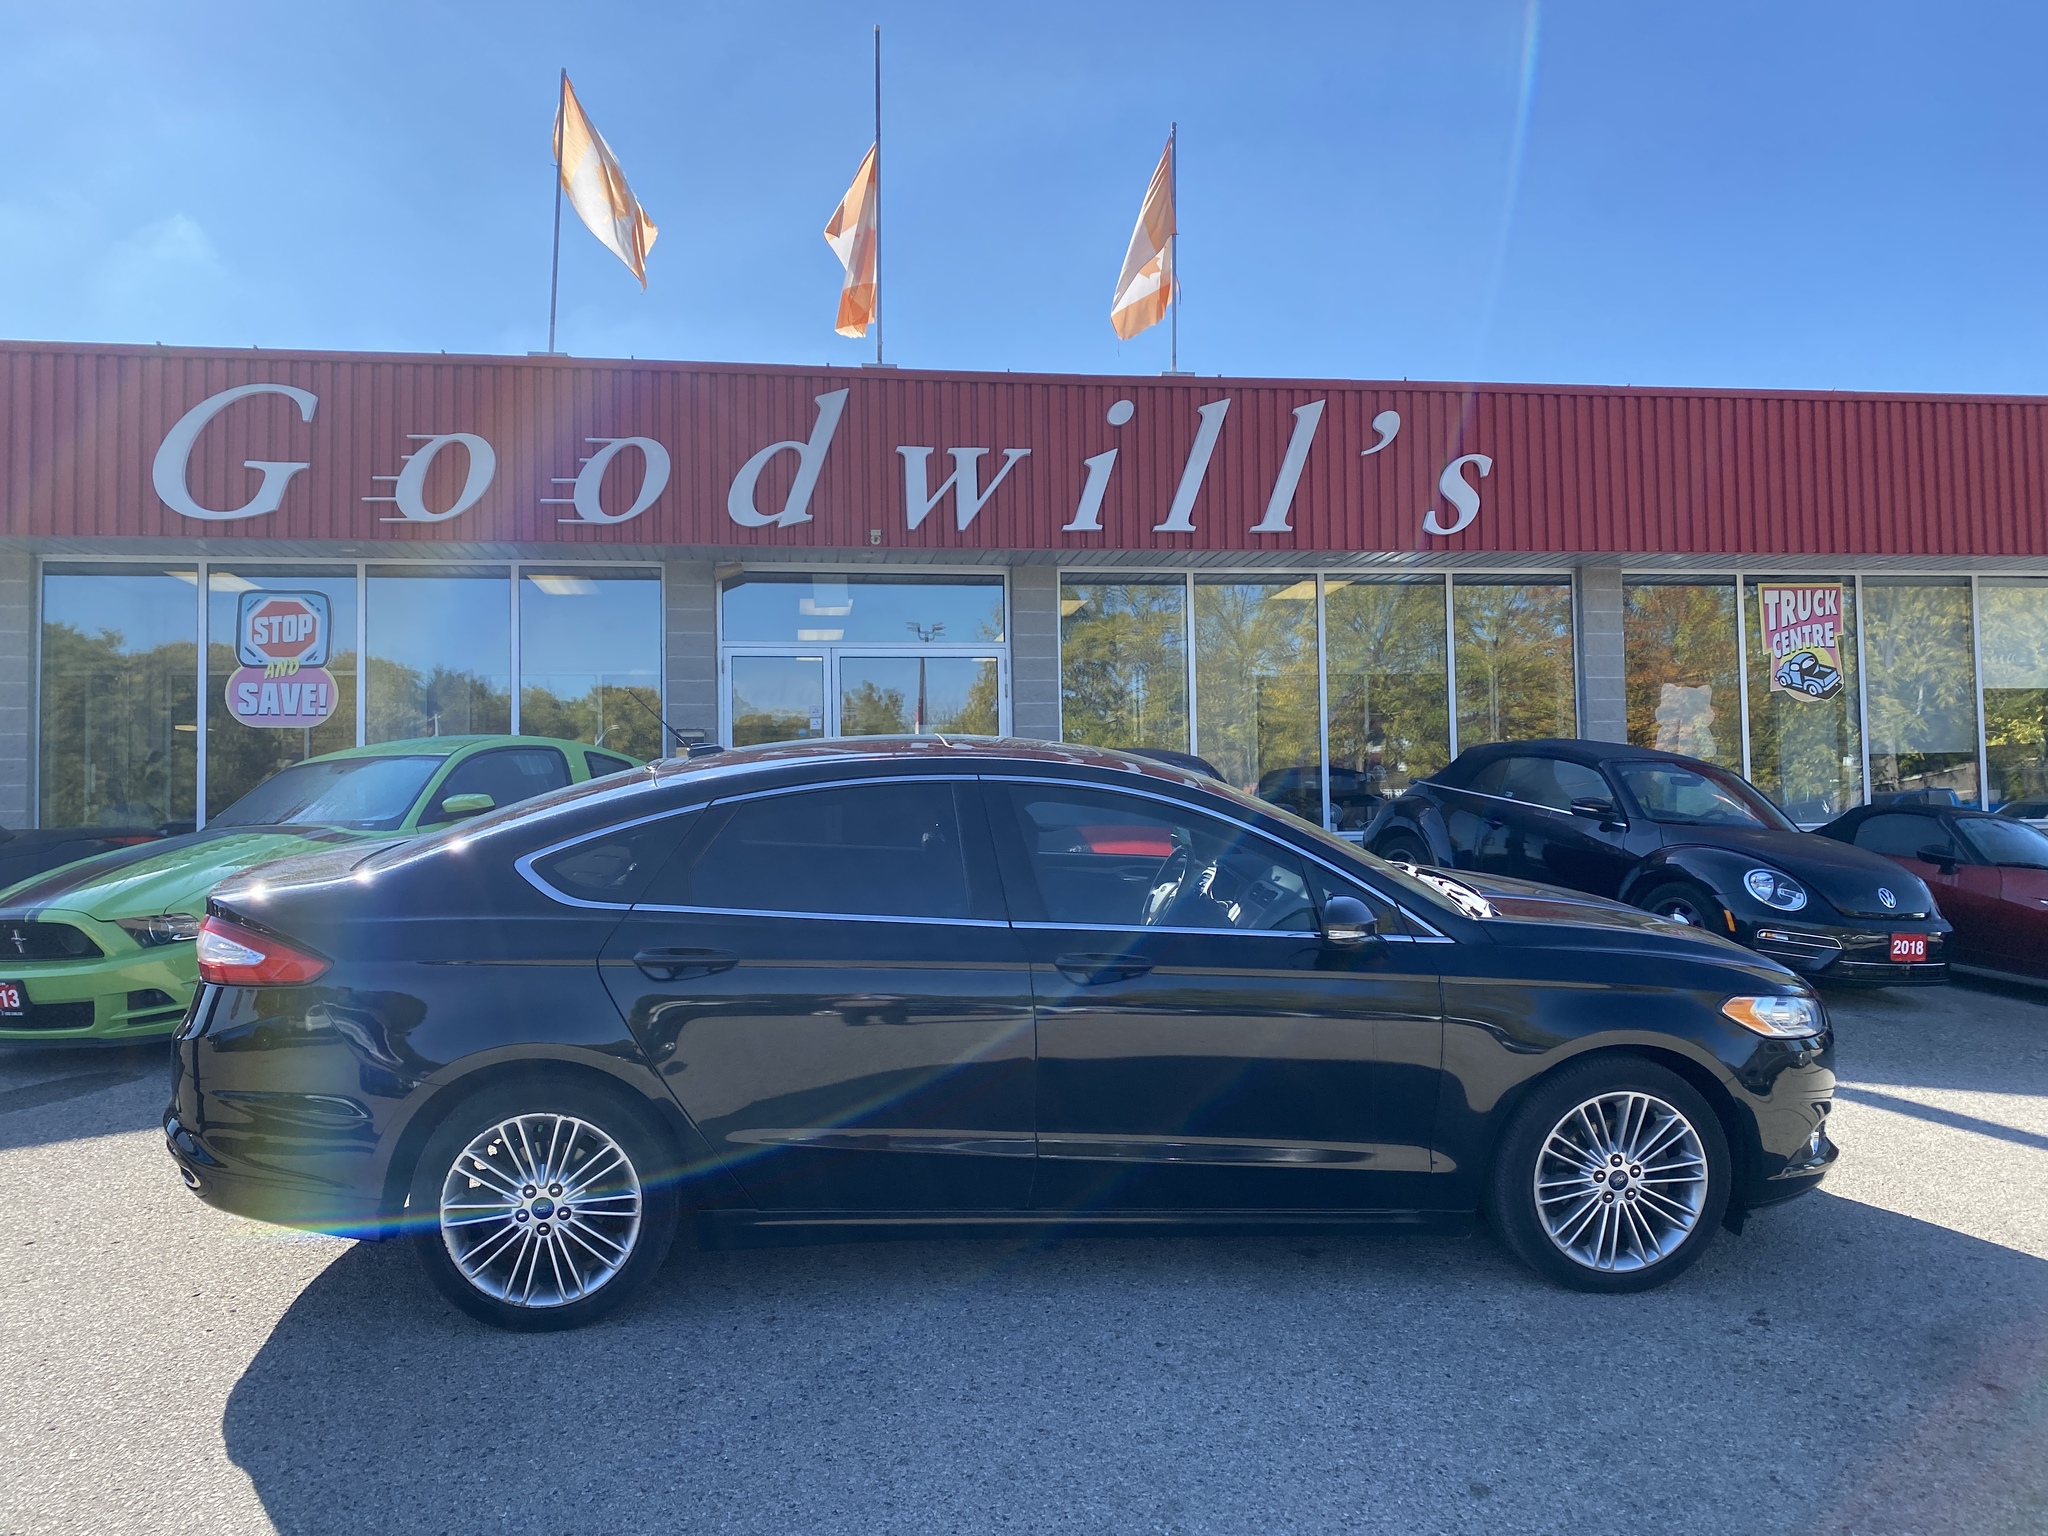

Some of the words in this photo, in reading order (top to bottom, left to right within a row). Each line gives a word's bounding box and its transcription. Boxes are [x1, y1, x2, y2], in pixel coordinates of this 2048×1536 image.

[151, 382, 1493, 537] Goodwill's
[1764, 589, 1838, 631] TRUCK
[253, 613, 313, 645] STOP
[1772, 621, 1835, 659] CENTRE
[264, 659, 299, 679] AND
[237, 682, 328, 716] SAVE!
[1893, 940, 1924, 955] 2018
